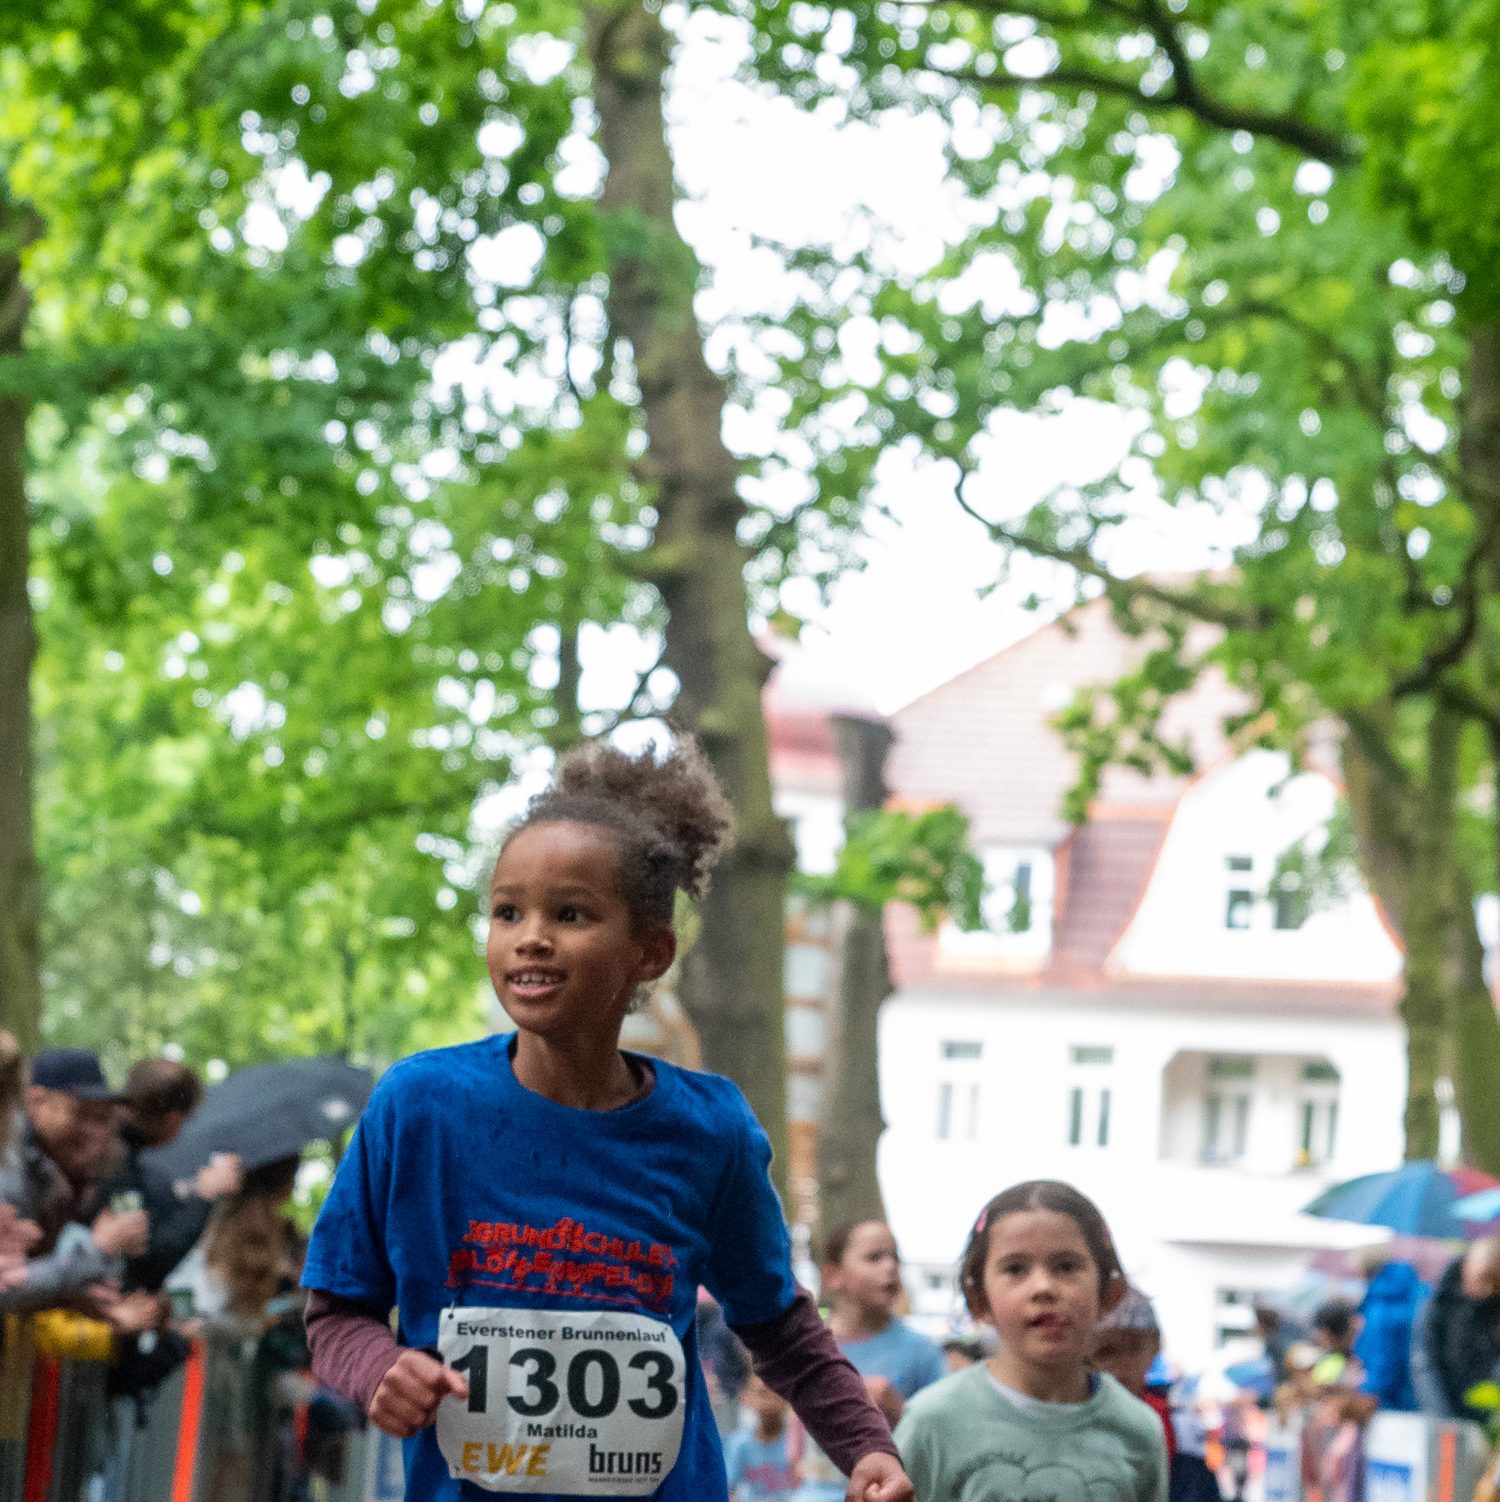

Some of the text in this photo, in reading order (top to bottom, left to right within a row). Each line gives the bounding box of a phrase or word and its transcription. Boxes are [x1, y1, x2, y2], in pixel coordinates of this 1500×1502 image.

[456, 1322, 666, 1343] Everstener Brunnenlauf
[450, 1344, 679, 1420] 1303
[526, 1423, 598, 1439] Matilda
[461, 1441, 662, 1477] EWE bruns
